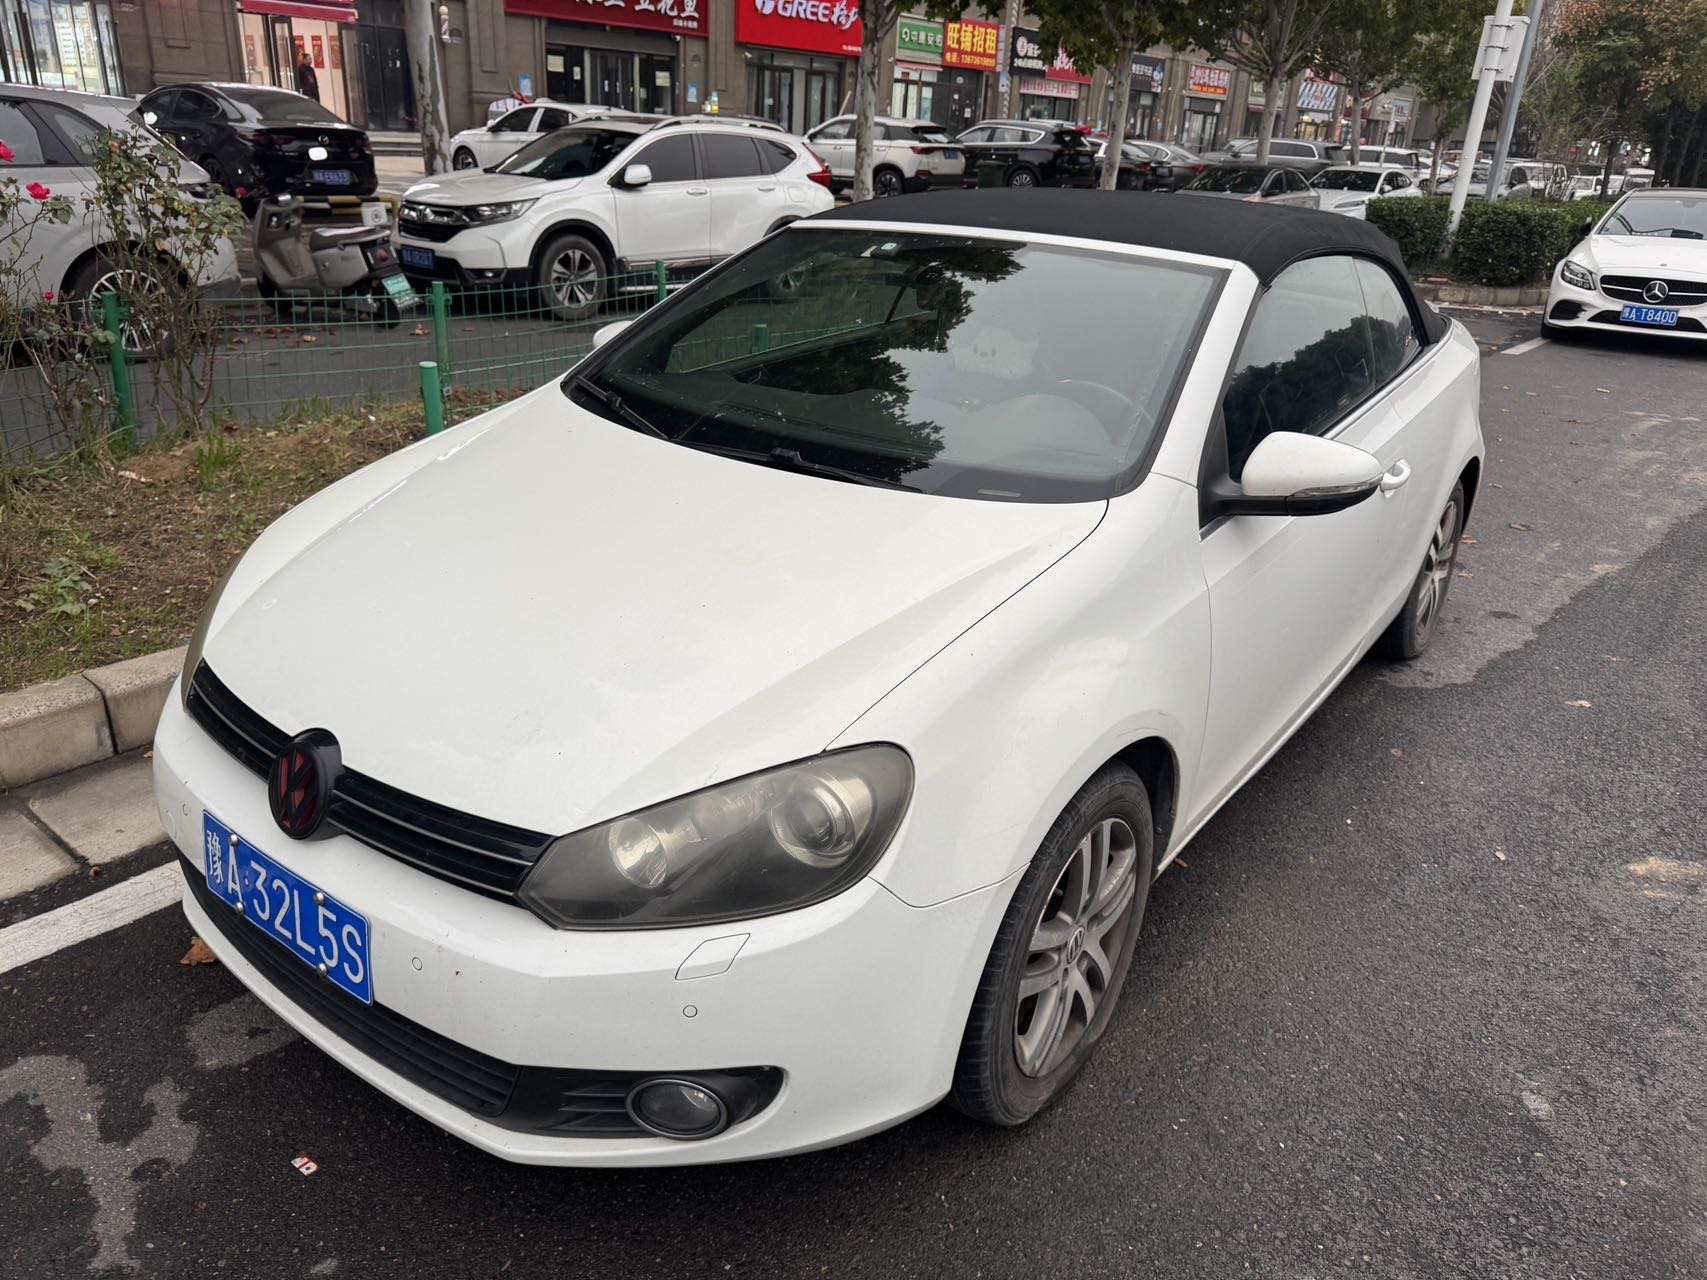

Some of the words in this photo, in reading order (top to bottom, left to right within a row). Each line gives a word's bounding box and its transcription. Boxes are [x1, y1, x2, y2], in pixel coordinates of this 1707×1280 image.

[777, 0, 831, 22] GREE
[947, 23, 997, 54] 旺铺招租
